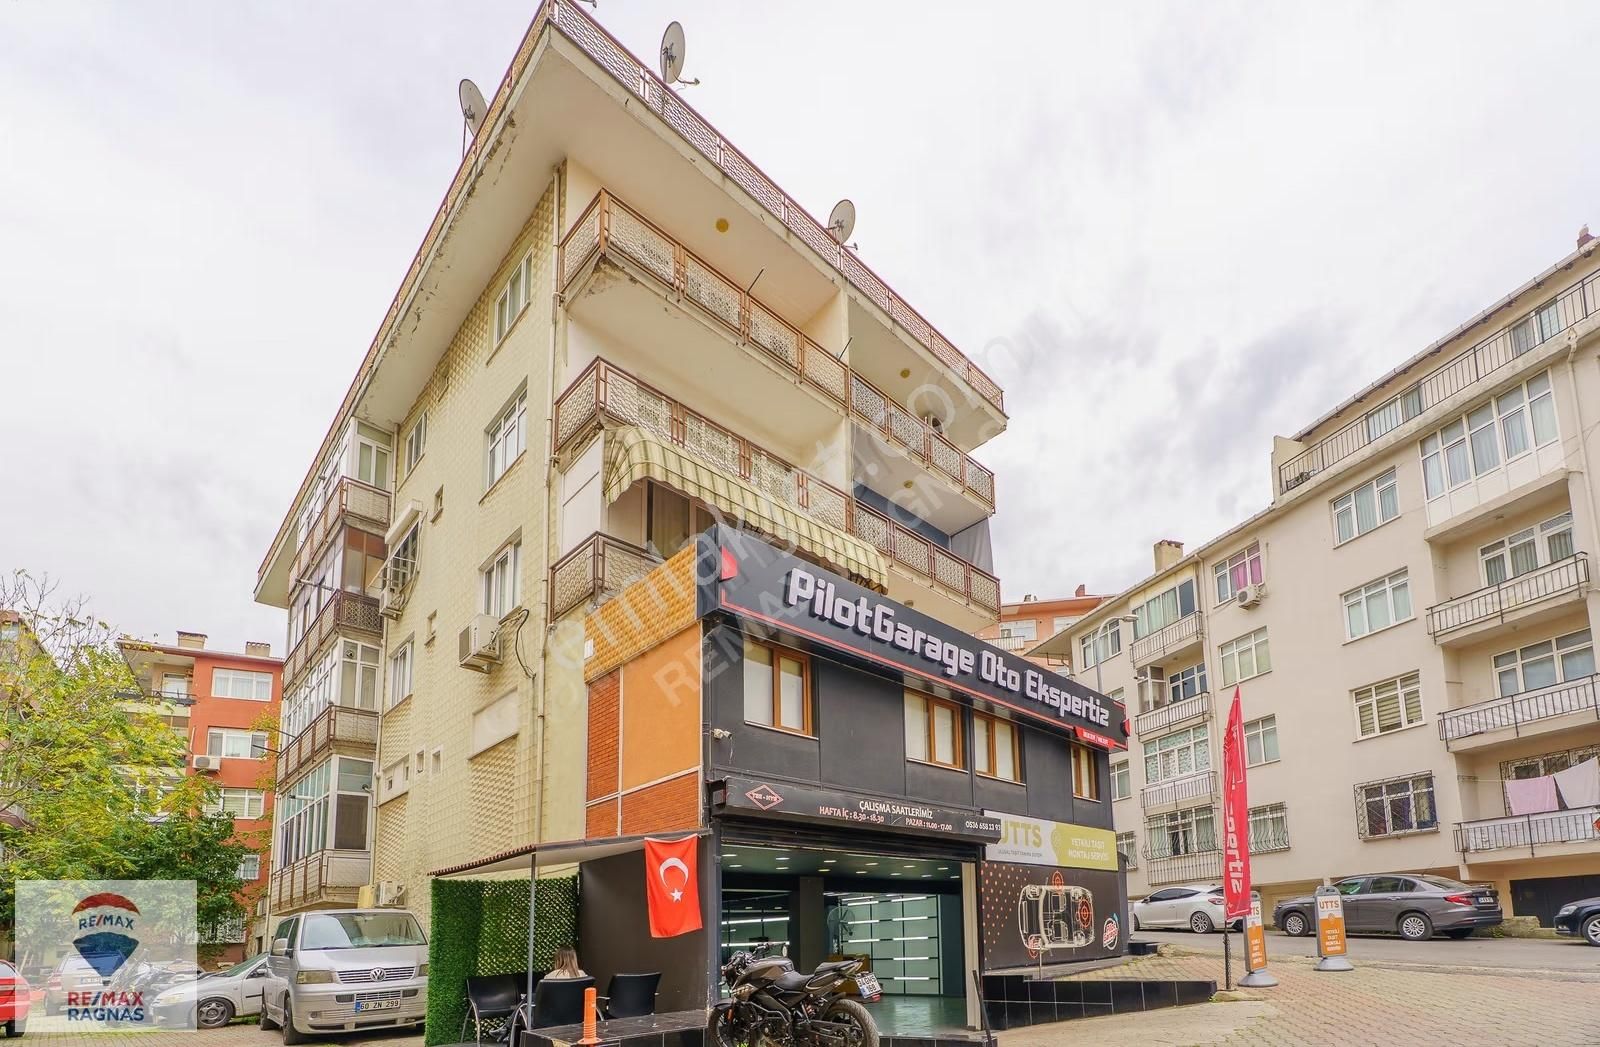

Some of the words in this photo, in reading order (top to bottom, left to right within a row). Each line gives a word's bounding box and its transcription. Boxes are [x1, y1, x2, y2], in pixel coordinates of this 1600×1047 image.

[787, 567, 975, 676] PilotGarage
[980, 649, 1021, 692] Oto
[1025, 669, 1109, 727] Ekspertiz
[819, 806, 841, 817] HAFTA
[859, 800, 891, 814] ÇALIŞMA
[891, 805, 933, 819] SAATLERİMİZ
[905, 817, 922, 826] PAZAR
[1319, 900, 1340, 909] UTTS
[386, 1000, 399, 1008] 299
